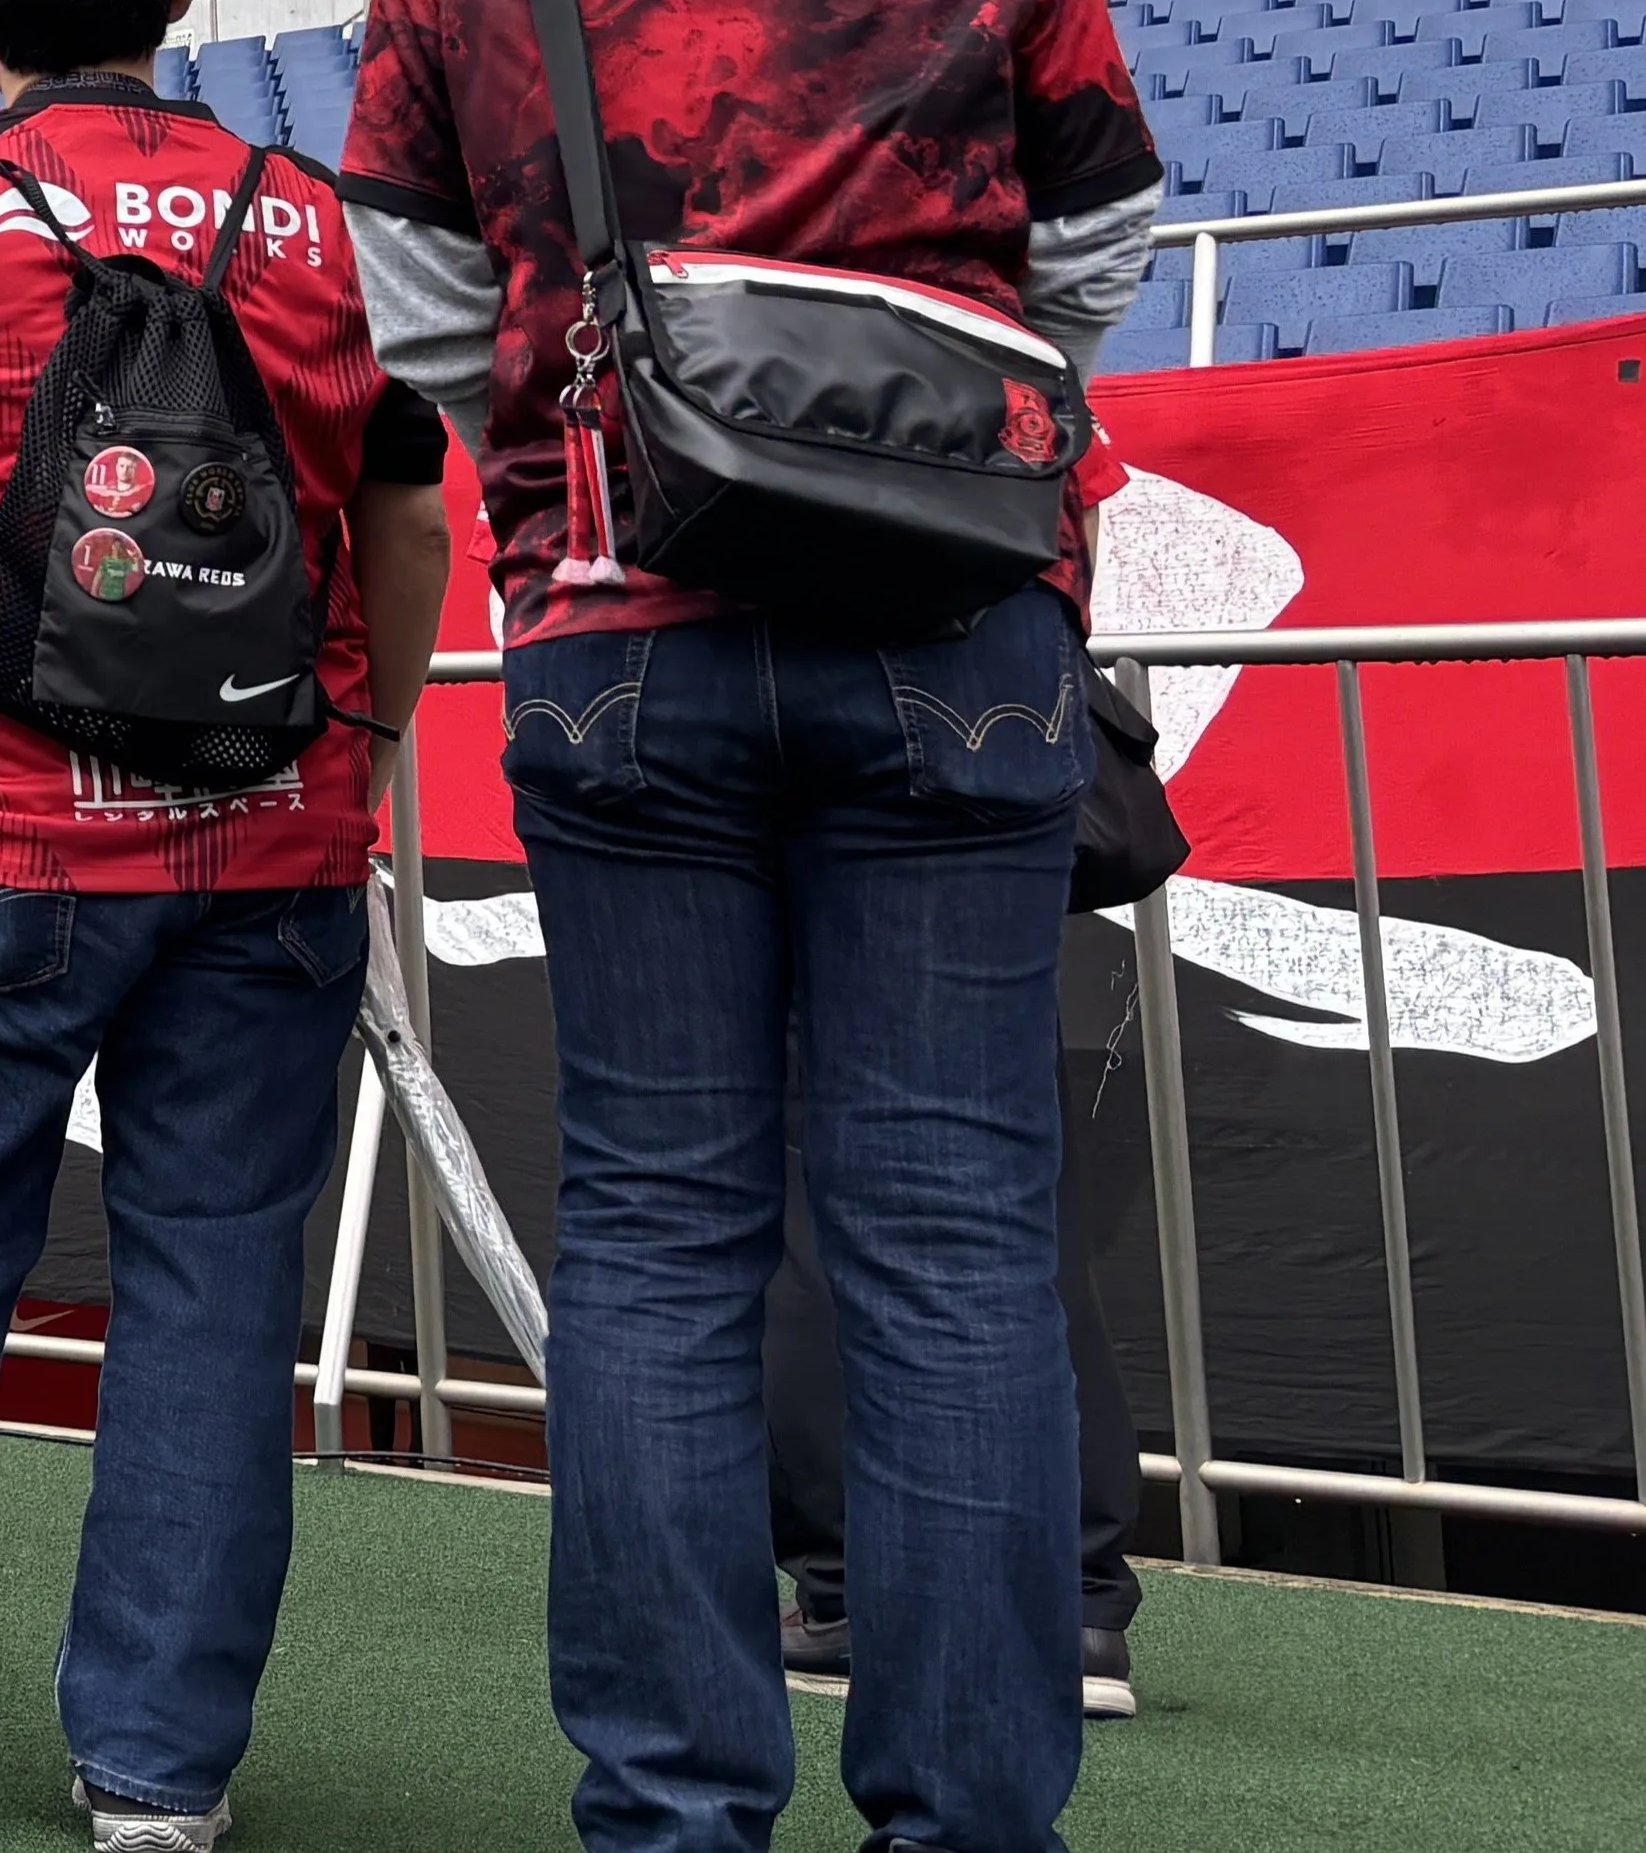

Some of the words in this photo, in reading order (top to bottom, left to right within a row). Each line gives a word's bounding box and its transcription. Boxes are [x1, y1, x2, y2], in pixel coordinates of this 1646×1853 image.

[115, 181, 320, 243] BONDI
[118, 227, 323, 267] WOKS
[144, 559, 193, 581] AWA
[199, 568, 246, 586] REDS
